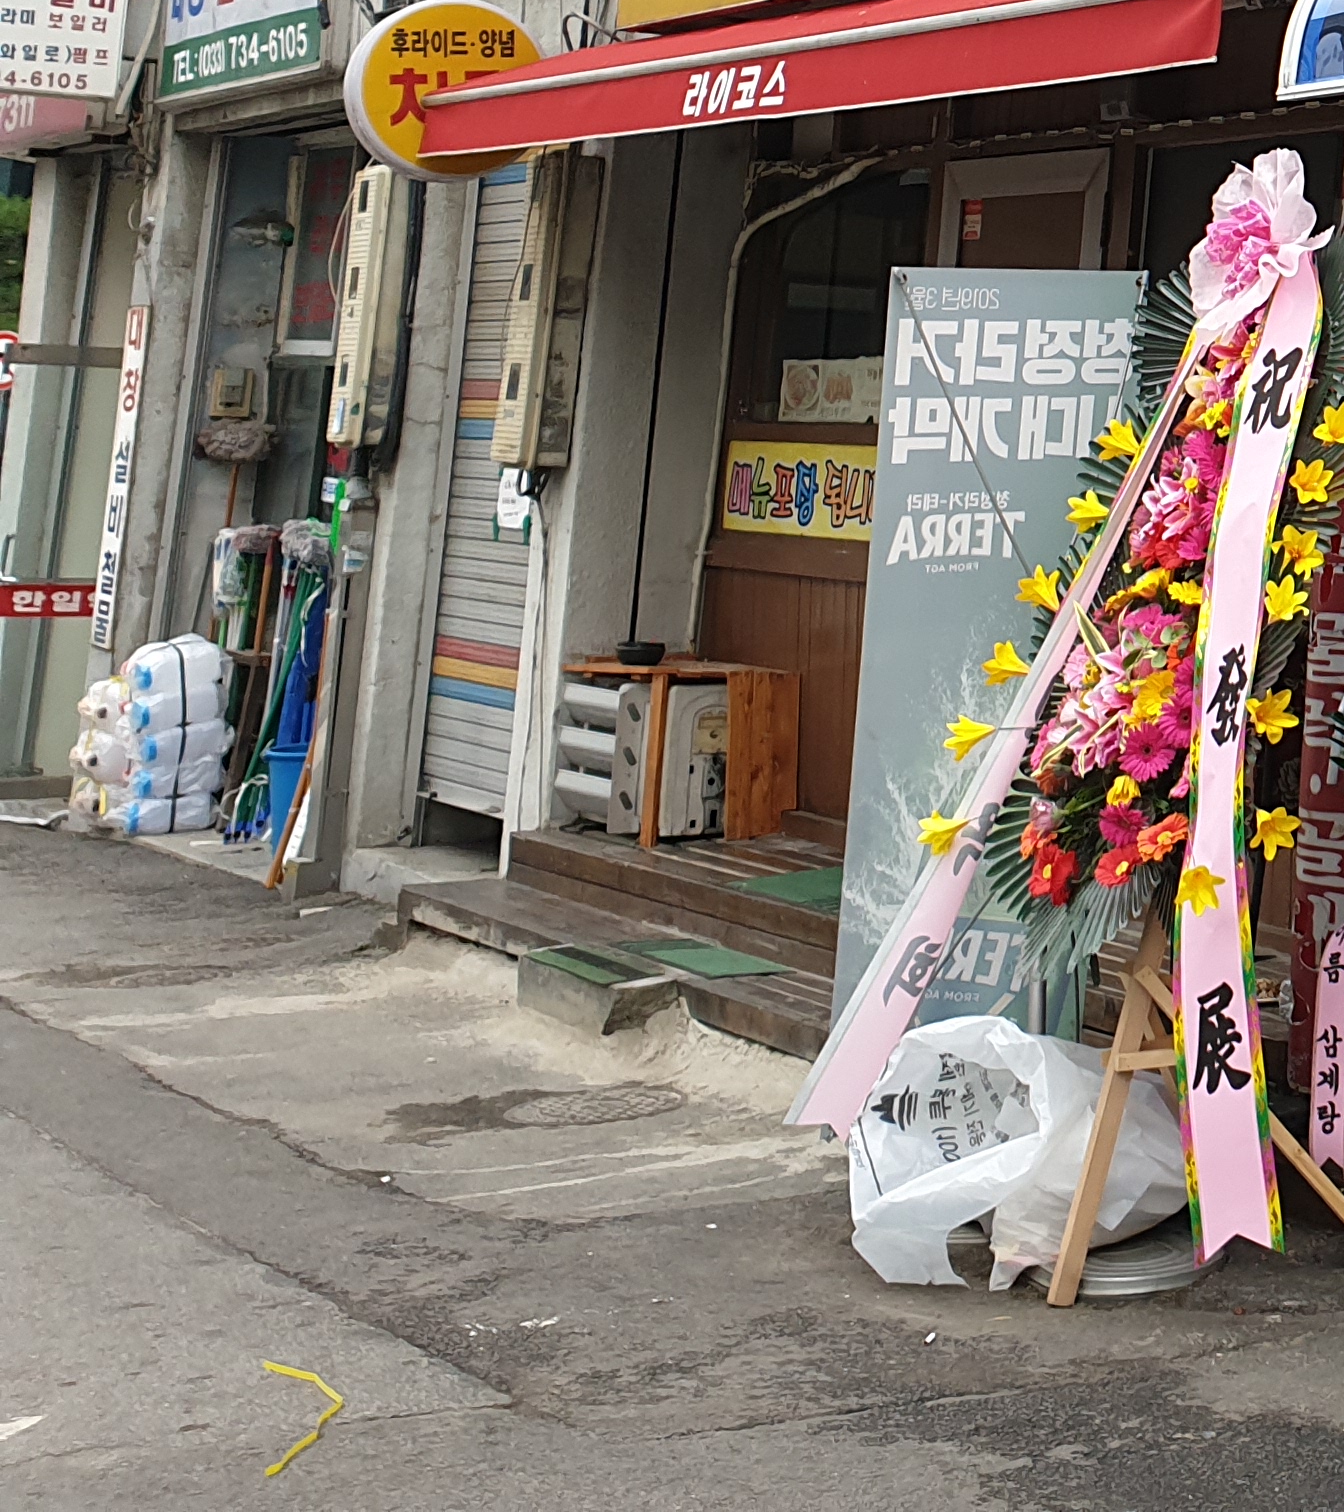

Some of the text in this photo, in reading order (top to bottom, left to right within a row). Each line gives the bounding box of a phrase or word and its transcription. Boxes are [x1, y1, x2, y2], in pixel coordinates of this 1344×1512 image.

[48, 12, 108, 34] 보일러
[228, 21, 308, 70] 734-6105
[683, 60, 786, 117] 라이코스
[111, 441, 131, 540] 설비
[823, 459, 877, 528] 됩니
